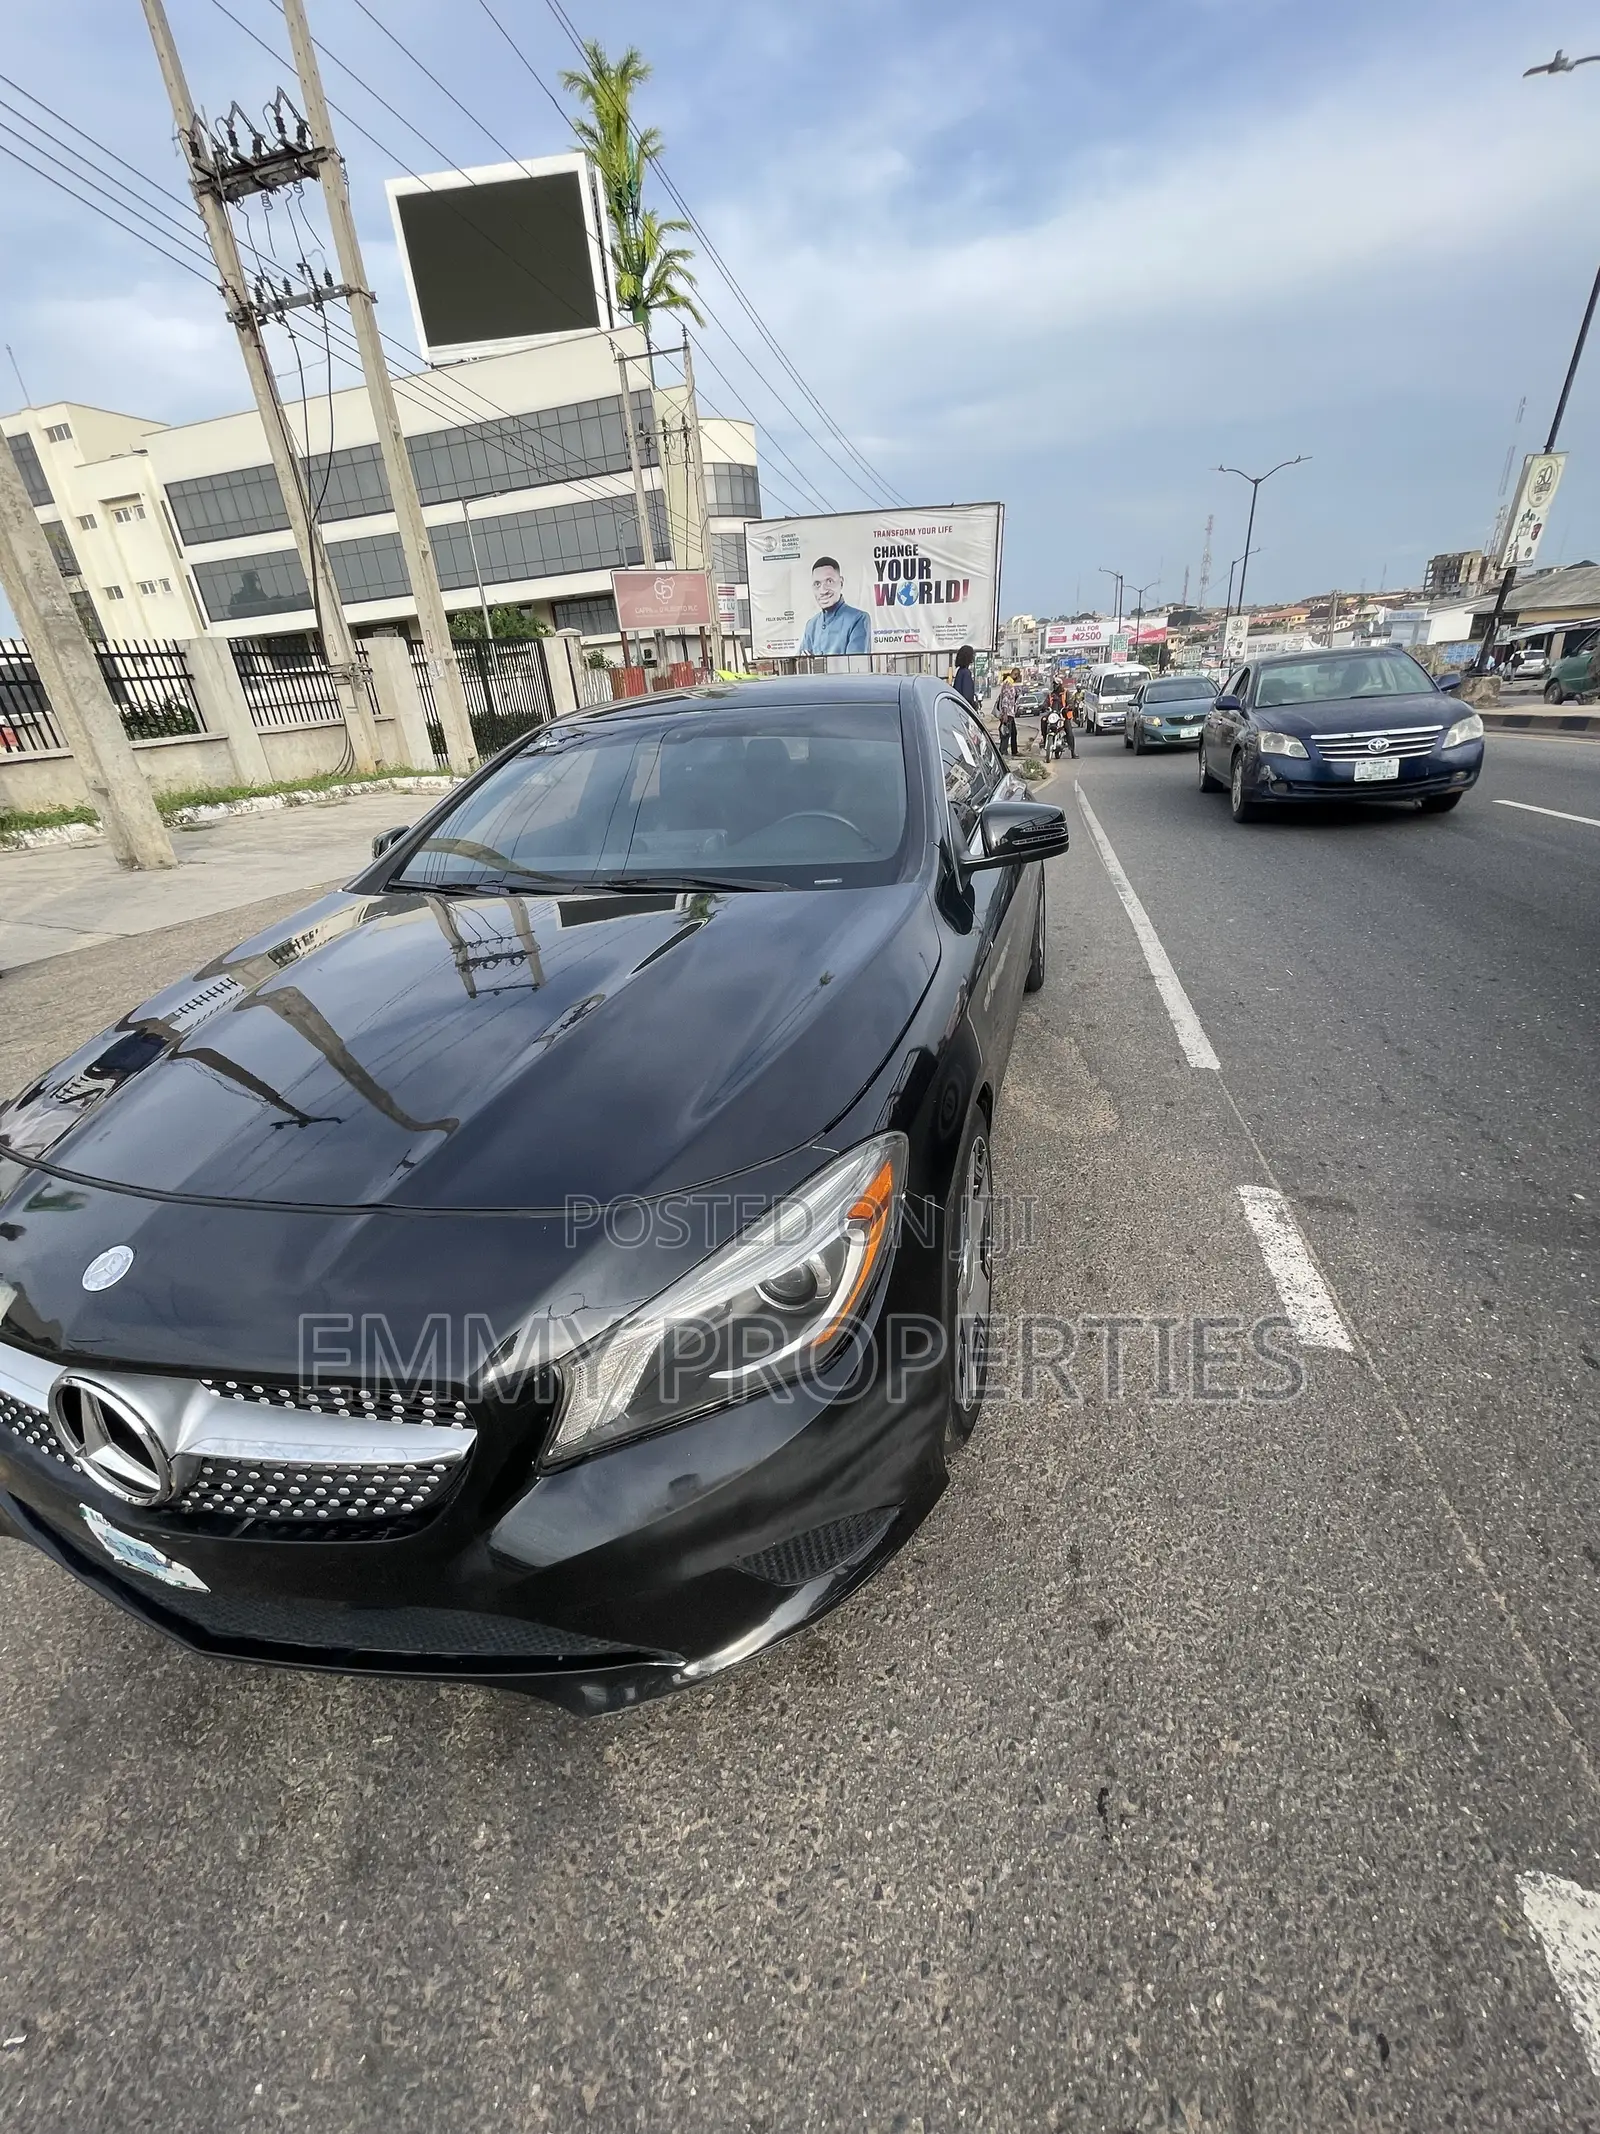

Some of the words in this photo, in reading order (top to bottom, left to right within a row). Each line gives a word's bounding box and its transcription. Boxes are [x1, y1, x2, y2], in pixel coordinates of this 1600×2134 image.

[873, 528, 916, 538] TRANSFORM
[918, 526, 936, 535] YOUR
[938, 525, 953, 533] LIFE
[873, 544, 919, 559] CHANGE
[874, 557, 932, 582] YOUR
